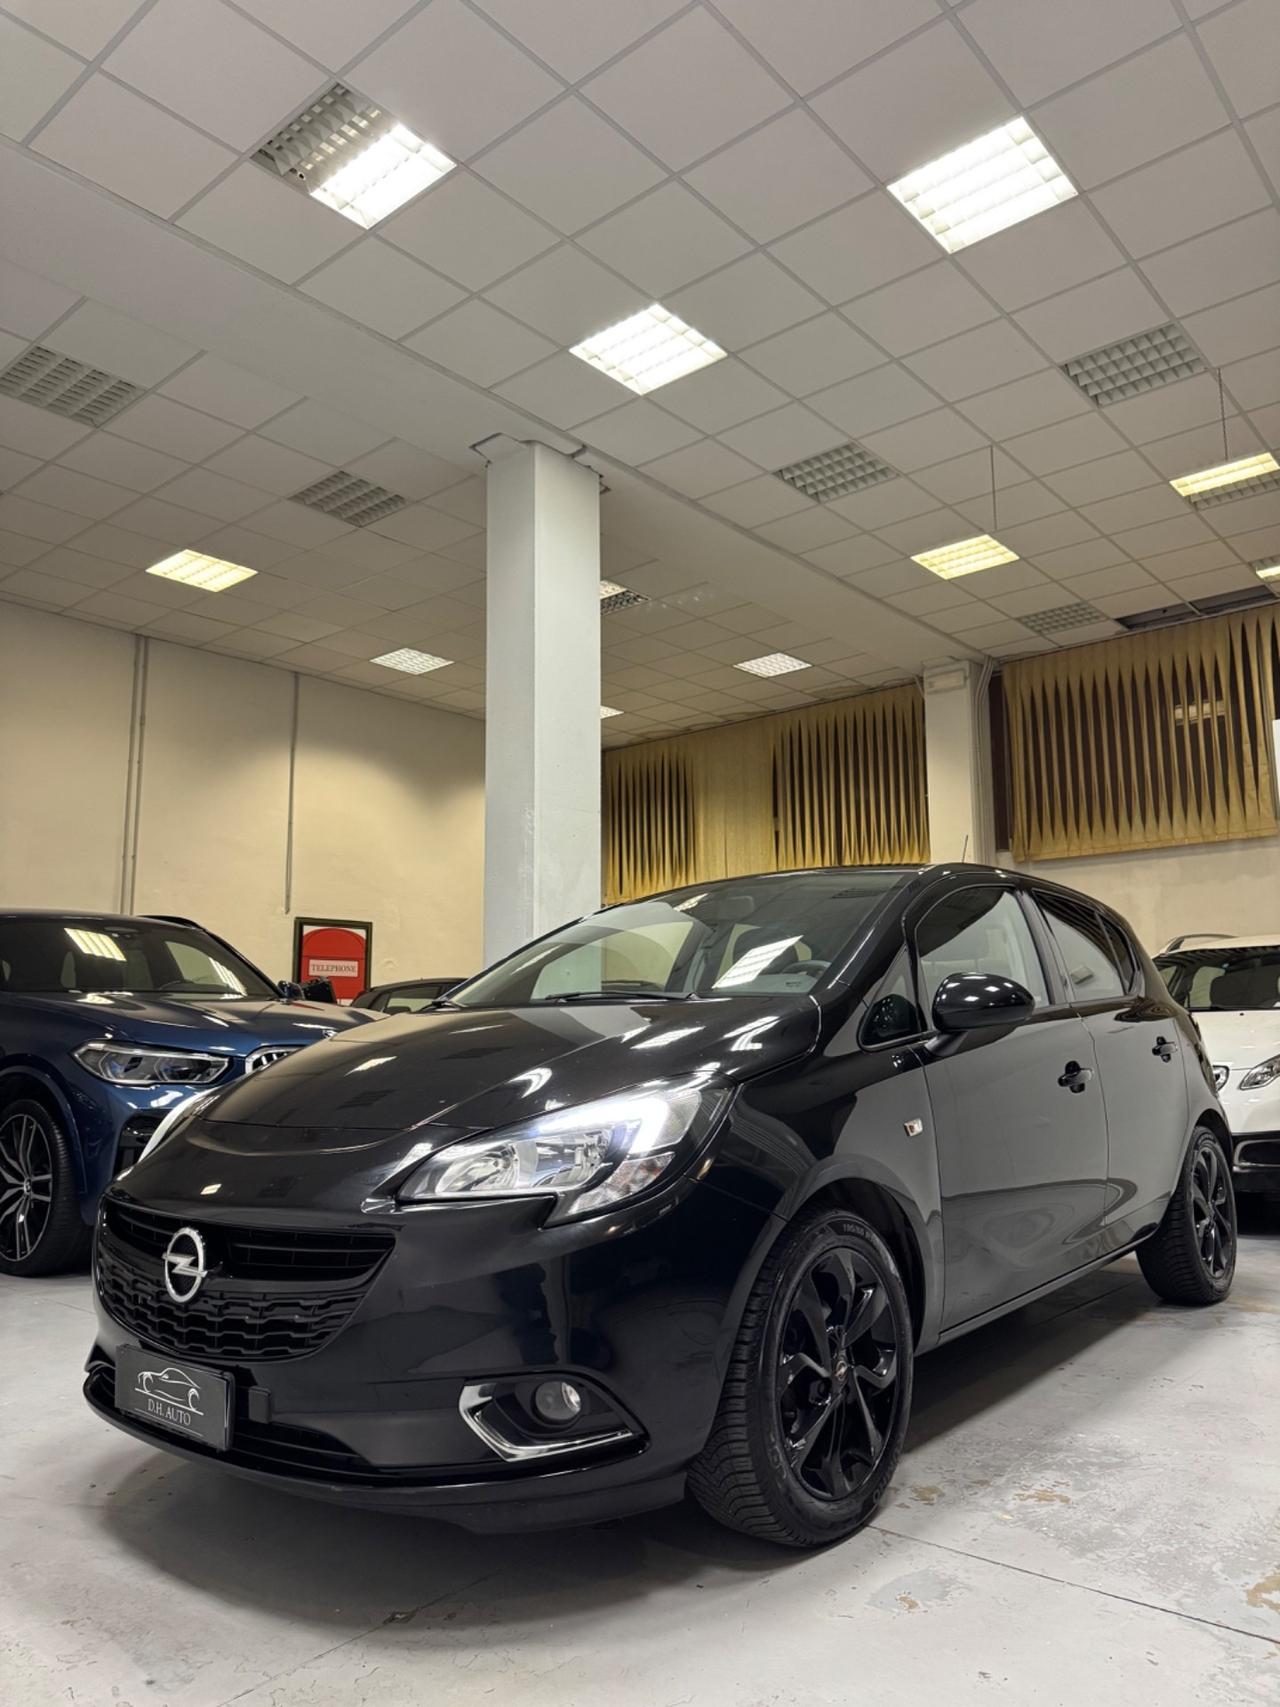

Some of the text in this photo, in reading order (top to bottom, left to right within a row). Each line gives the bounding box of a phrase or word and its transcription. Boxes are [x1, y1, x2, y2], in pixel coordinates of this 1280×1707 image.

[312, 964, 356, 973] TELEPHONE
[147, 1398, 191, 1426] D.H. AUTO
